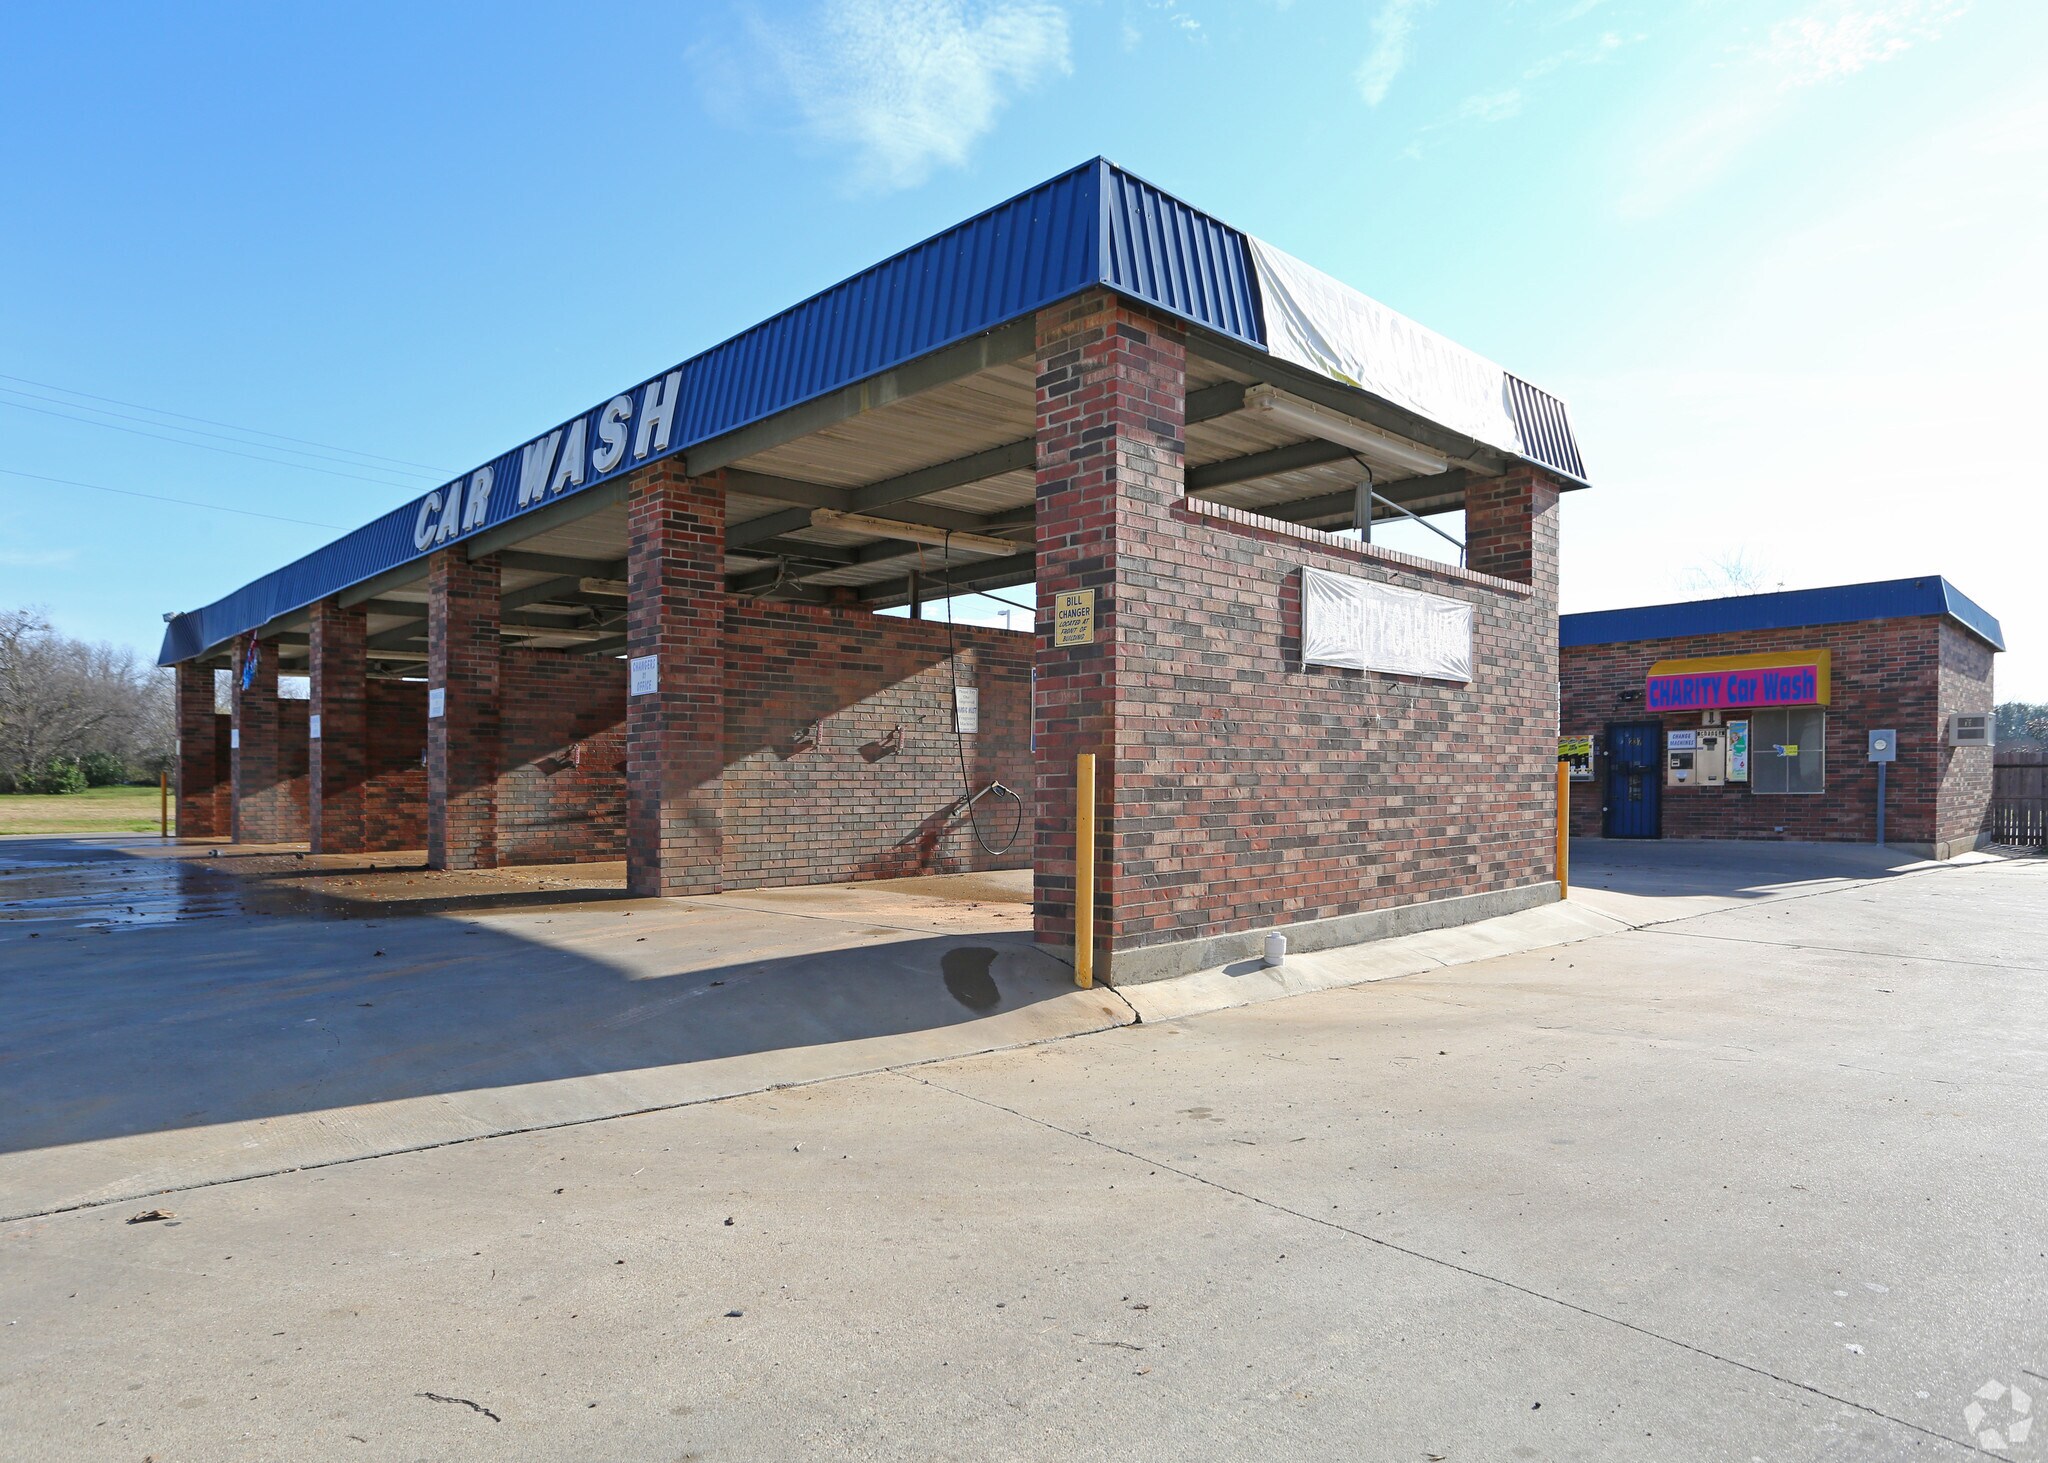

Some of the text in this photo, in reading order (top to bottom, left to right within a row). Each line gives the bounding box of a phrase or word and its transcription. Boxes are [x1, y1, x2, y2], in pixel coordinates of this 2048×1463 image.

[414, 370, 682, 551] CAR WASH
[1066, 596, 1082, 606] BILL
[1058, 607, 1091, 619] CHANGER
[1059, 619, 1081, 627] LOCATED
[1650, 669, 1815, 708] CHARITY Car Wash
